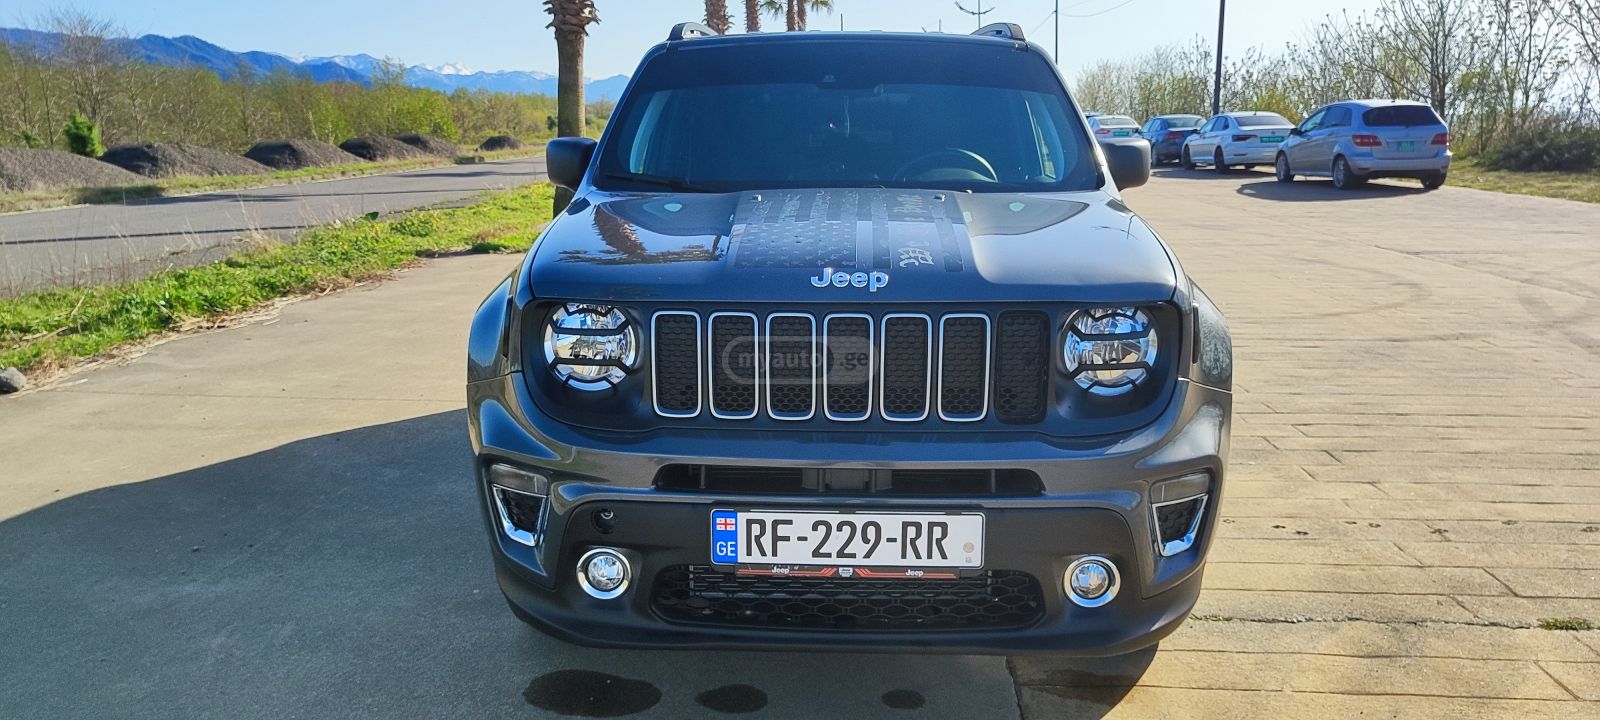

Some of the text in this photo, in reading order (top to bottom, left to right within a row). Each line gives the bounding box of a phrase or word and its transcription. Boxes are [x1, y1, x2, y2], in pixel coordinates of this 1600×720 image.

[810, 267, 888, 292] Jeep
[745, 518, 948, 560] RF-229-RR
[716, 541, 736, 557] GE
[771, 566, 790, 575] Jeep
[905, 569, 925, 577] Jeep
